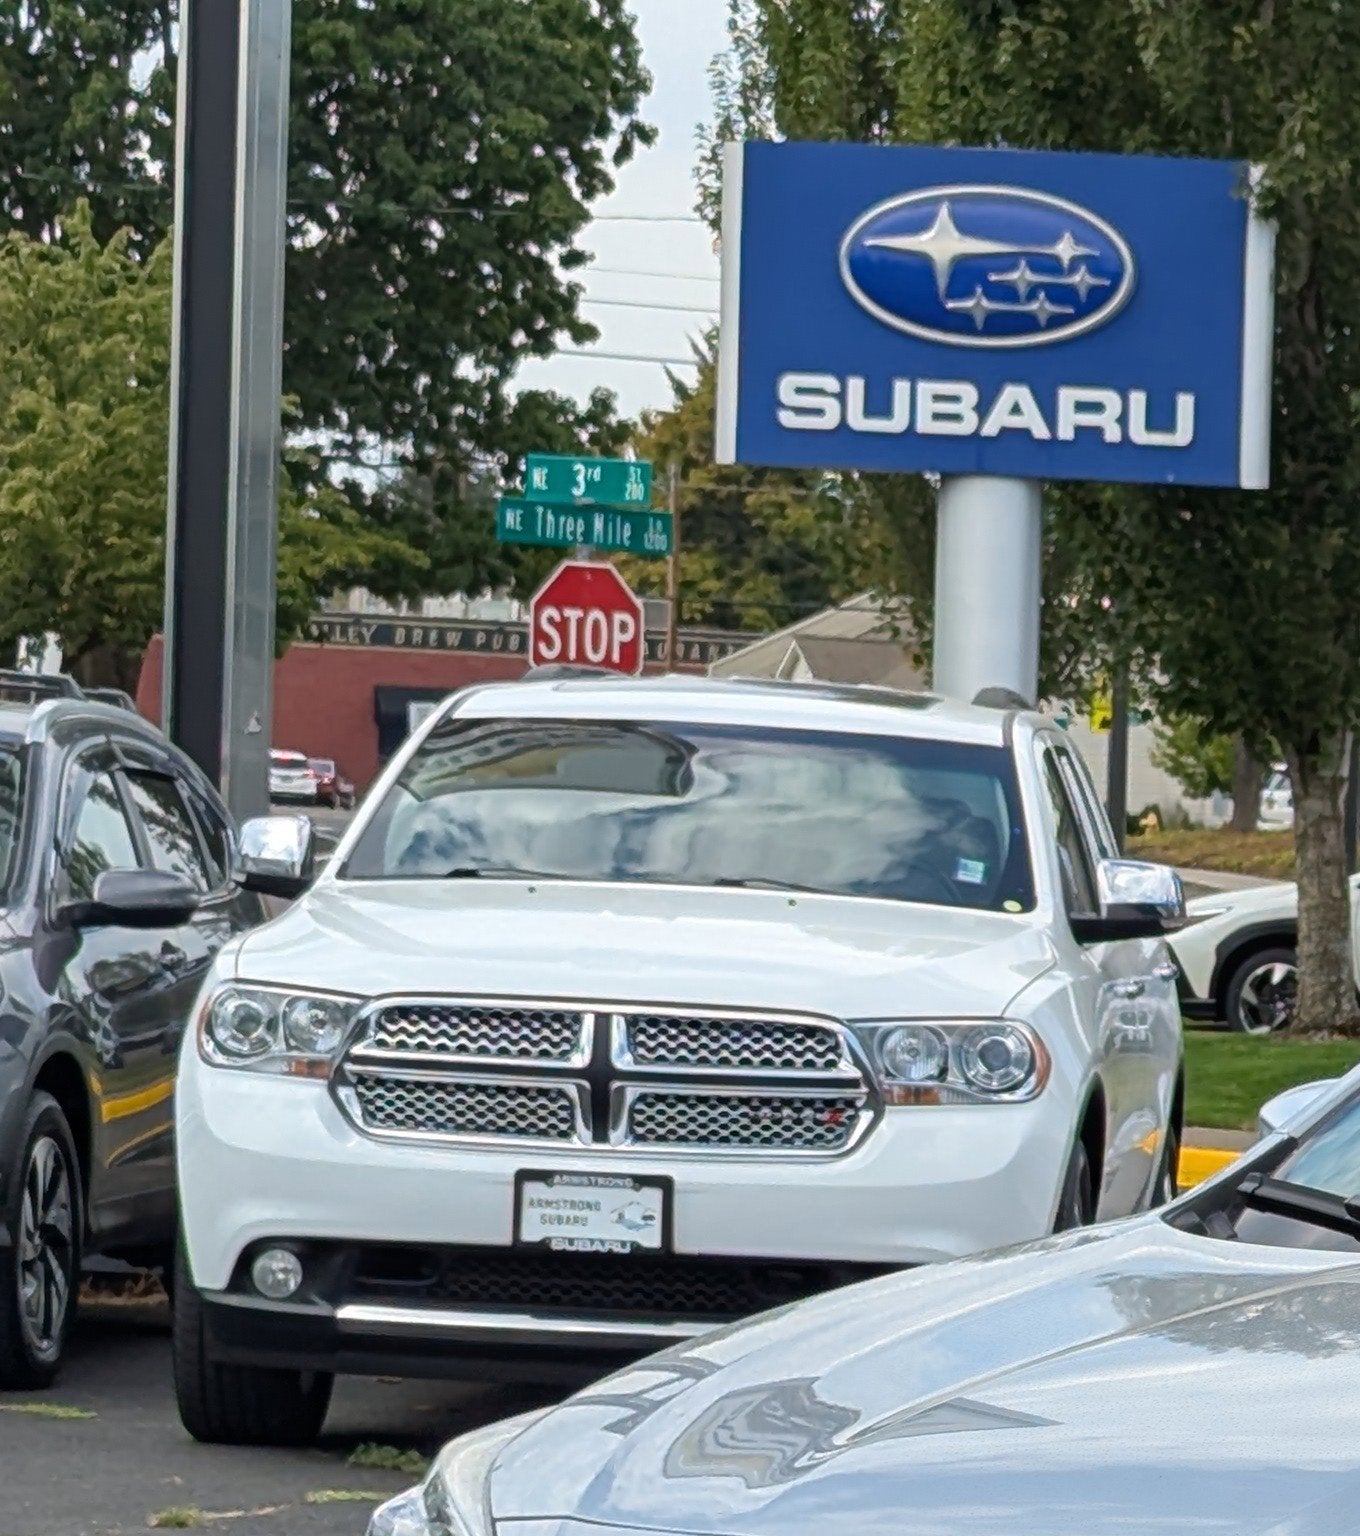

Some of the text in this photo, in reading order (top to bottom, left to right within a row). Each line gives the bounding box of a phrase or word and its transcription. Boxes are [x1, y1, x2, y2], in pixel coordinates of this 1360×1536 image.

[776, 371, 1196, 448] SUBARU
[532, 462, 602, 497] NE 3rd
[505, 505, 632, 547] NE Three Mile
[474, 630, 521, 652] PUB
[538, 606, 635, 664] STOP
[528, 1197, 602, 1212] ARMSTRONG
[540, 1213, 589, 1227] SUBARU
[551, 1238, 632, 1253] SUBARU
